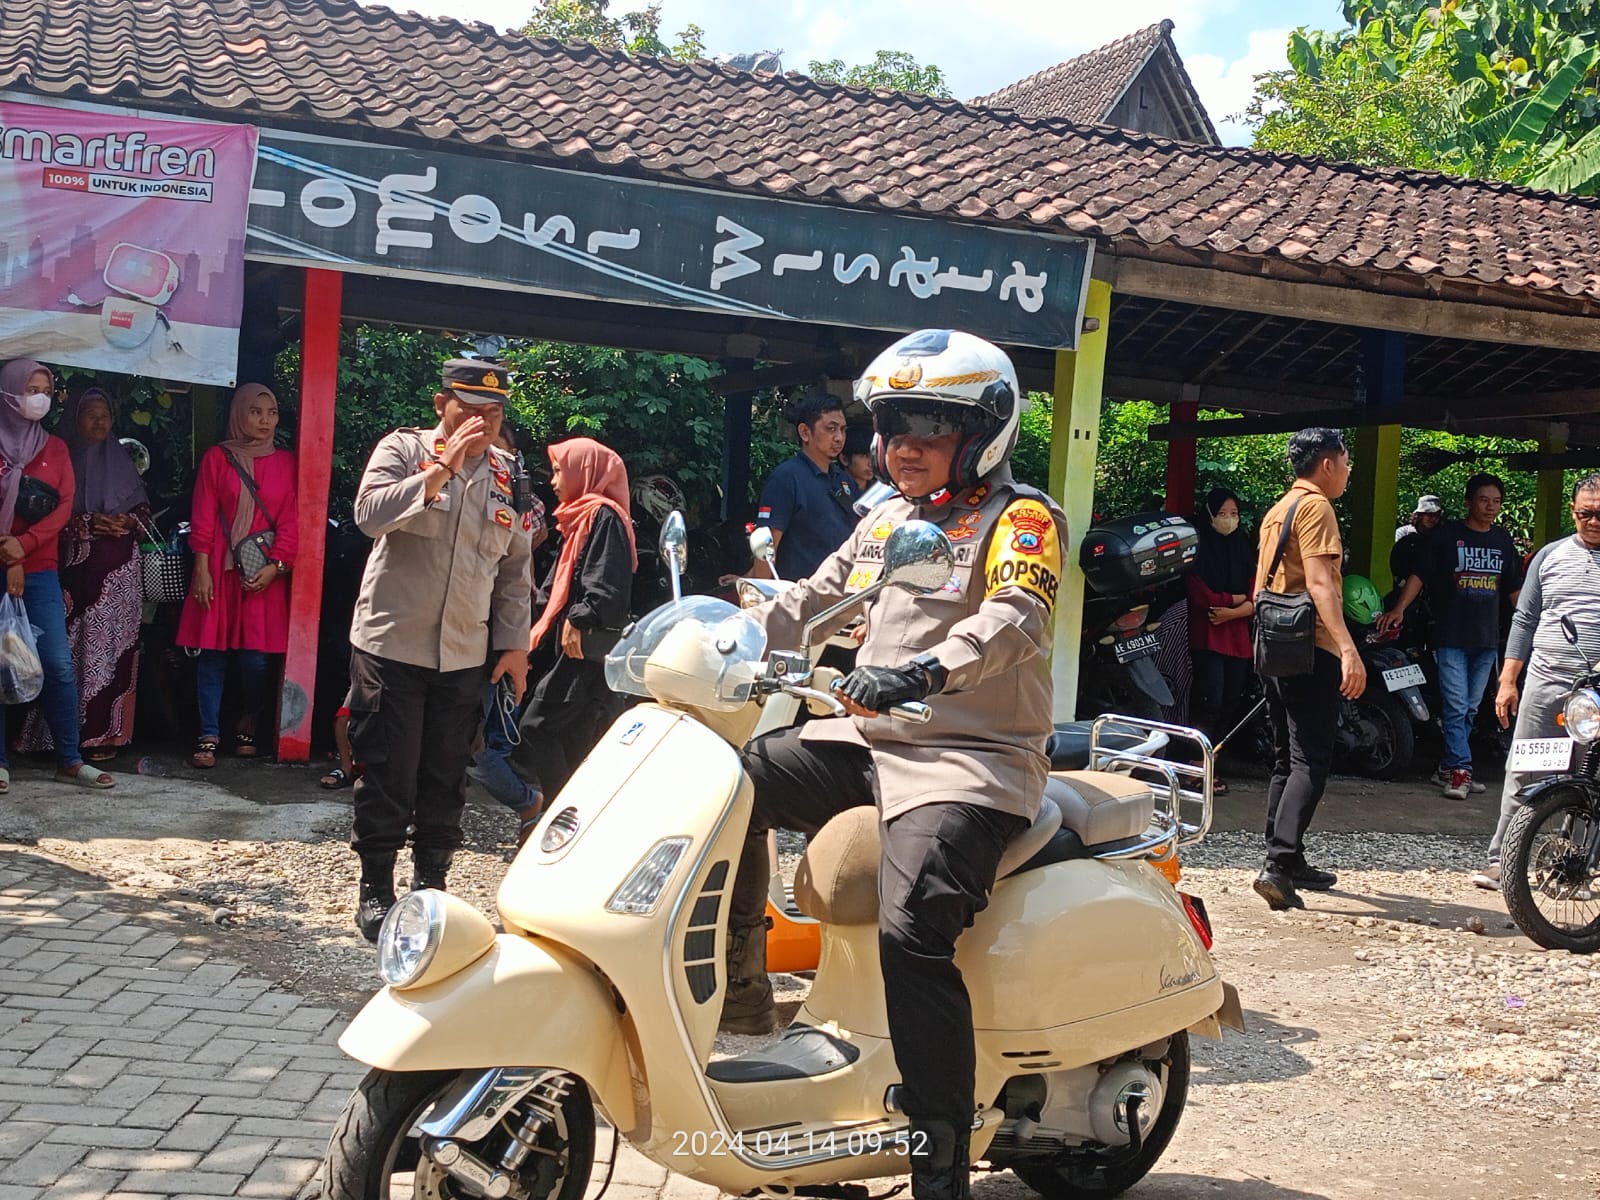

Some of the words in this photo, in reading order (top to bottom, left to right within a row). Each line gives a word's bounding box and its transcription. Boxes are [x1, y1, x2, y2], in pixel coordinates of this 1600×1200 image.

[48, 174, 85, 186] 100%
[92, 178, 137, 193] UNTUK
[140, 183, 209, 197] INDONESIA
[1115, 643, 1126, 653] AE
[1515, 743, 1526, 755] AG
[1529, 741, 1551, 755] 5558
